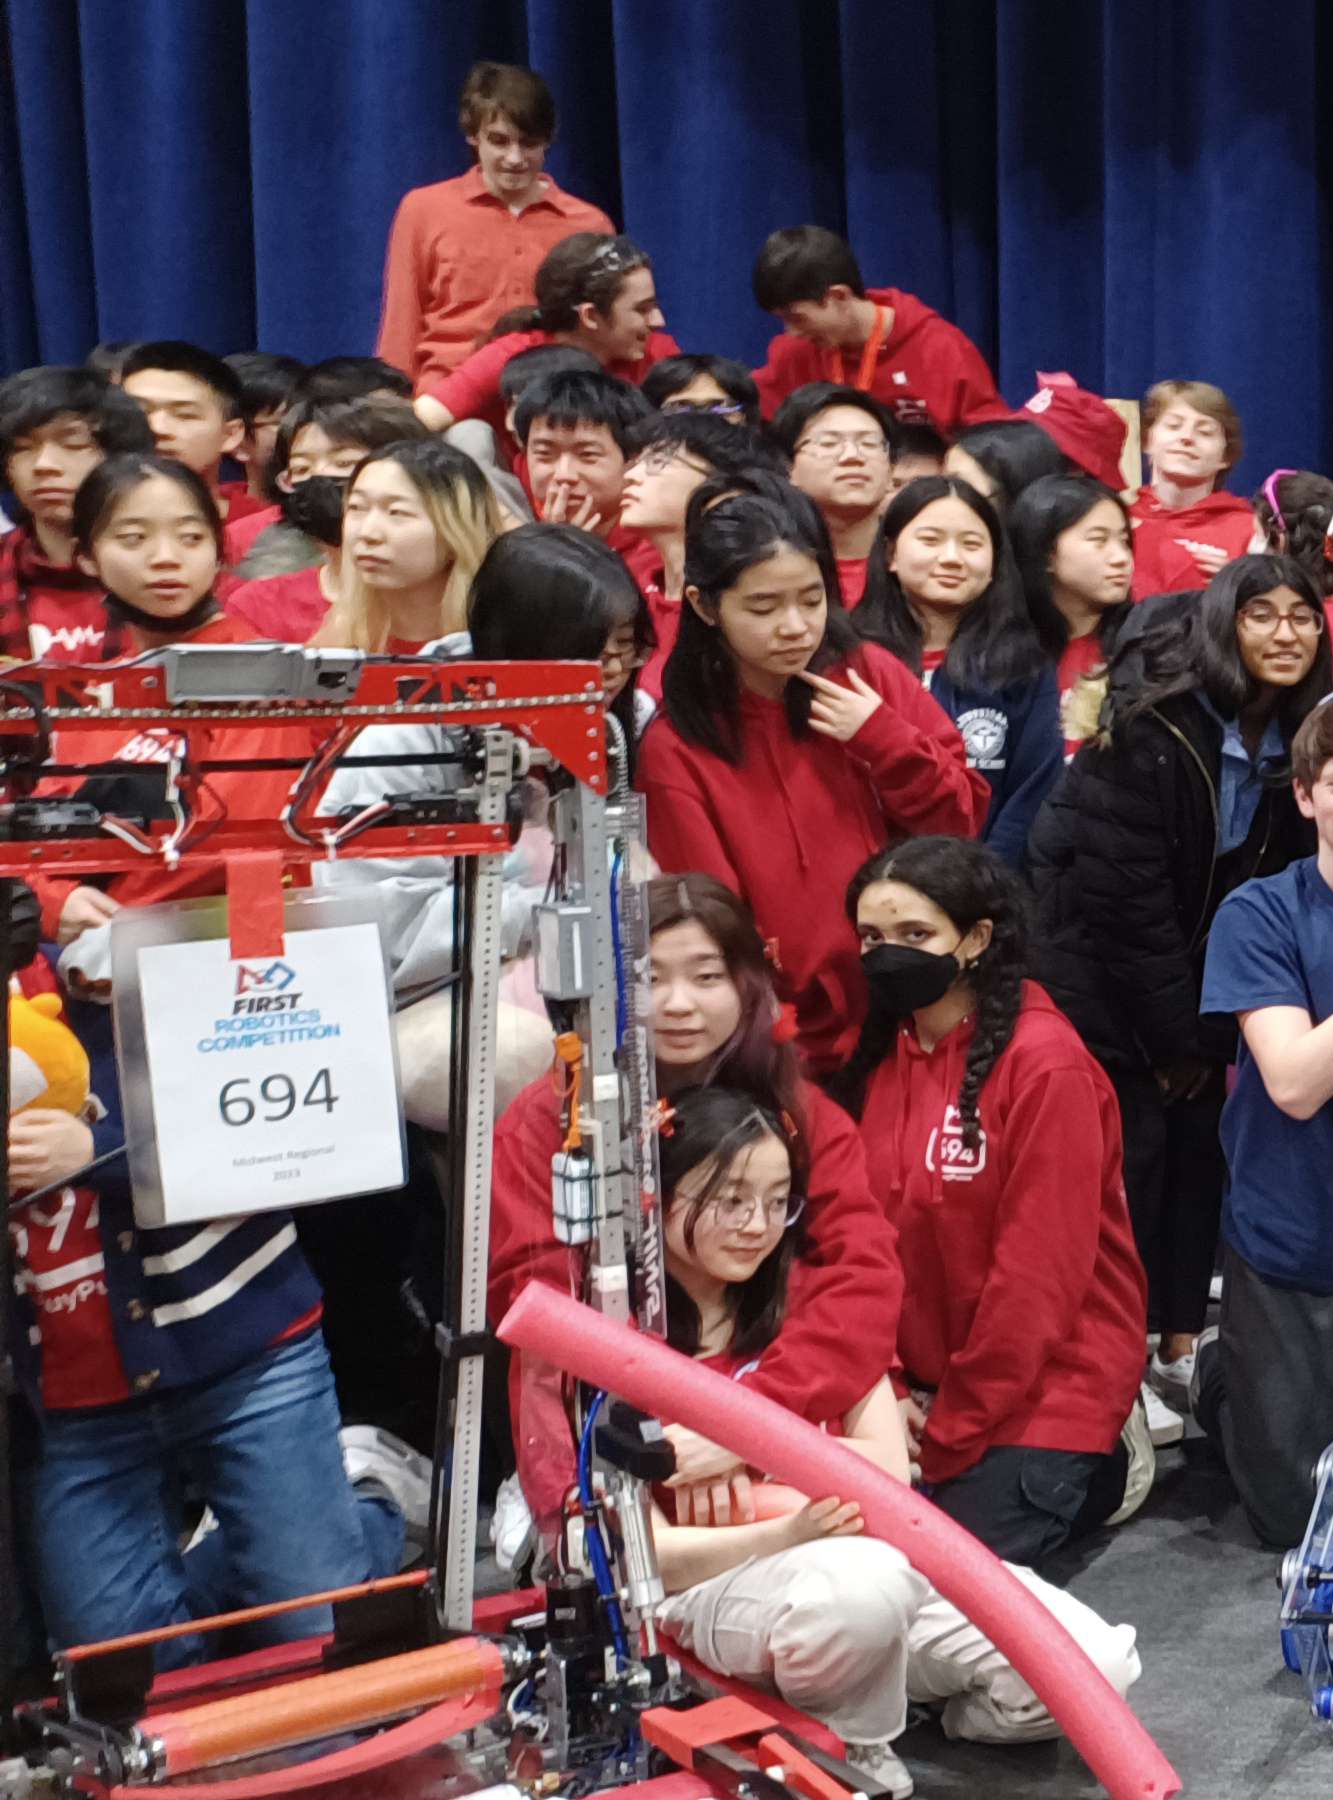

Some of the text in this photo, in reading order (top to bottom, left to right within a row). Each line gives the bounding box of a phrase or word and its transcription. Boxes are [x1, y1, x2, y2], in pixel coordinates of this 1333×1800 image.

[232, 992, 303, 1015] FIRST
[213, 1009, 321, 1033] ROBOTICS
[196, 1023, 341, 1053] COMPETITION
[218, 1067, 340, 1127] 694
[232, 1144, 337, 1168] Midwest Regional
